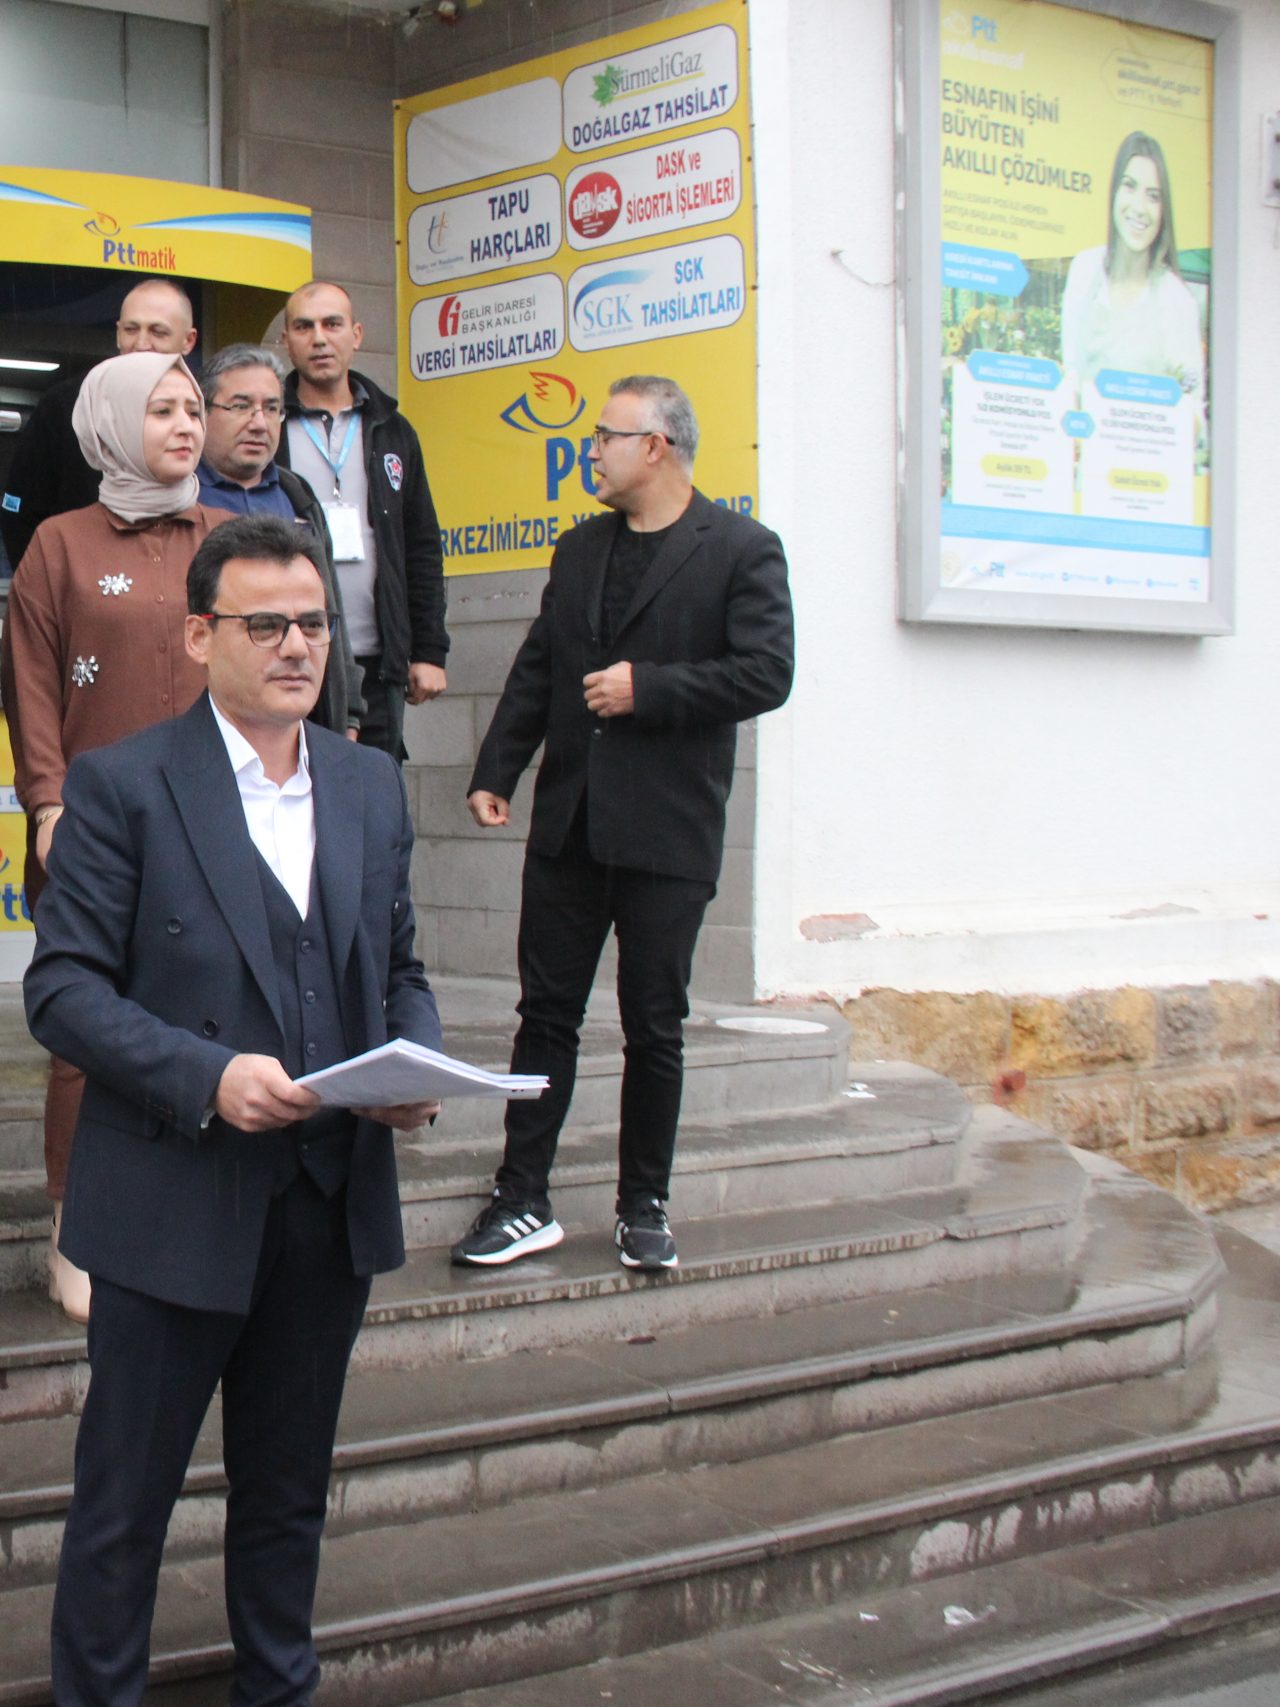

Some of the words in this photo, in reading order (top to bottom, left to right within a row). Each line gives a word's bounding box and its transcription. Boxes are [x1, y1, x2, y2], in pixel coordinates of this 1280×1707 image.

[611, 51, 703, 95] SürmeliGaz
[573, 106, 651, 147] DOĞALGAZ
[655, 84, 729, 125] TAHSİLAT
[942, 79, 1018, 115] ESNAFIN
[1020, 90, 1060, 125] İŞİNİ
[942, 109, 1025, 149] BÜYÜTEN
[656, 149, 687, 180] DASK
[688, 151, 702, 170] ve
[942, 146, 998, 176] AKILLI
[1001, 154, 1093, 195] ÇÖZÜMLER
[488, 188, 530, 221] TAPU
[626, 191, 674, 226] SİGORTA
[676, 170, 735, 220] İŞLEMLERİ
[102, 238, 177, 271] Pttmatik
[470, 222, 551, 263] HARÇLARI
[674, 256, 704, 285] SGK
[461, 305, 492, 321] GELİR
[494, 294, 536, 314] İDARESİ
[461, 310, 536, 334] BAŞKANLIĞI
[582, 293, 634, 332] SGK
[641, 286, 741, 328] TAHSİLATLARI
[416, 341, 456, 374] VERGİ
[459, 328, 557, 366] TAHSİLATLARI
[545, 437, 600, 502] Pt
[441, 514, 560, 557] RKEZİMİZDE
